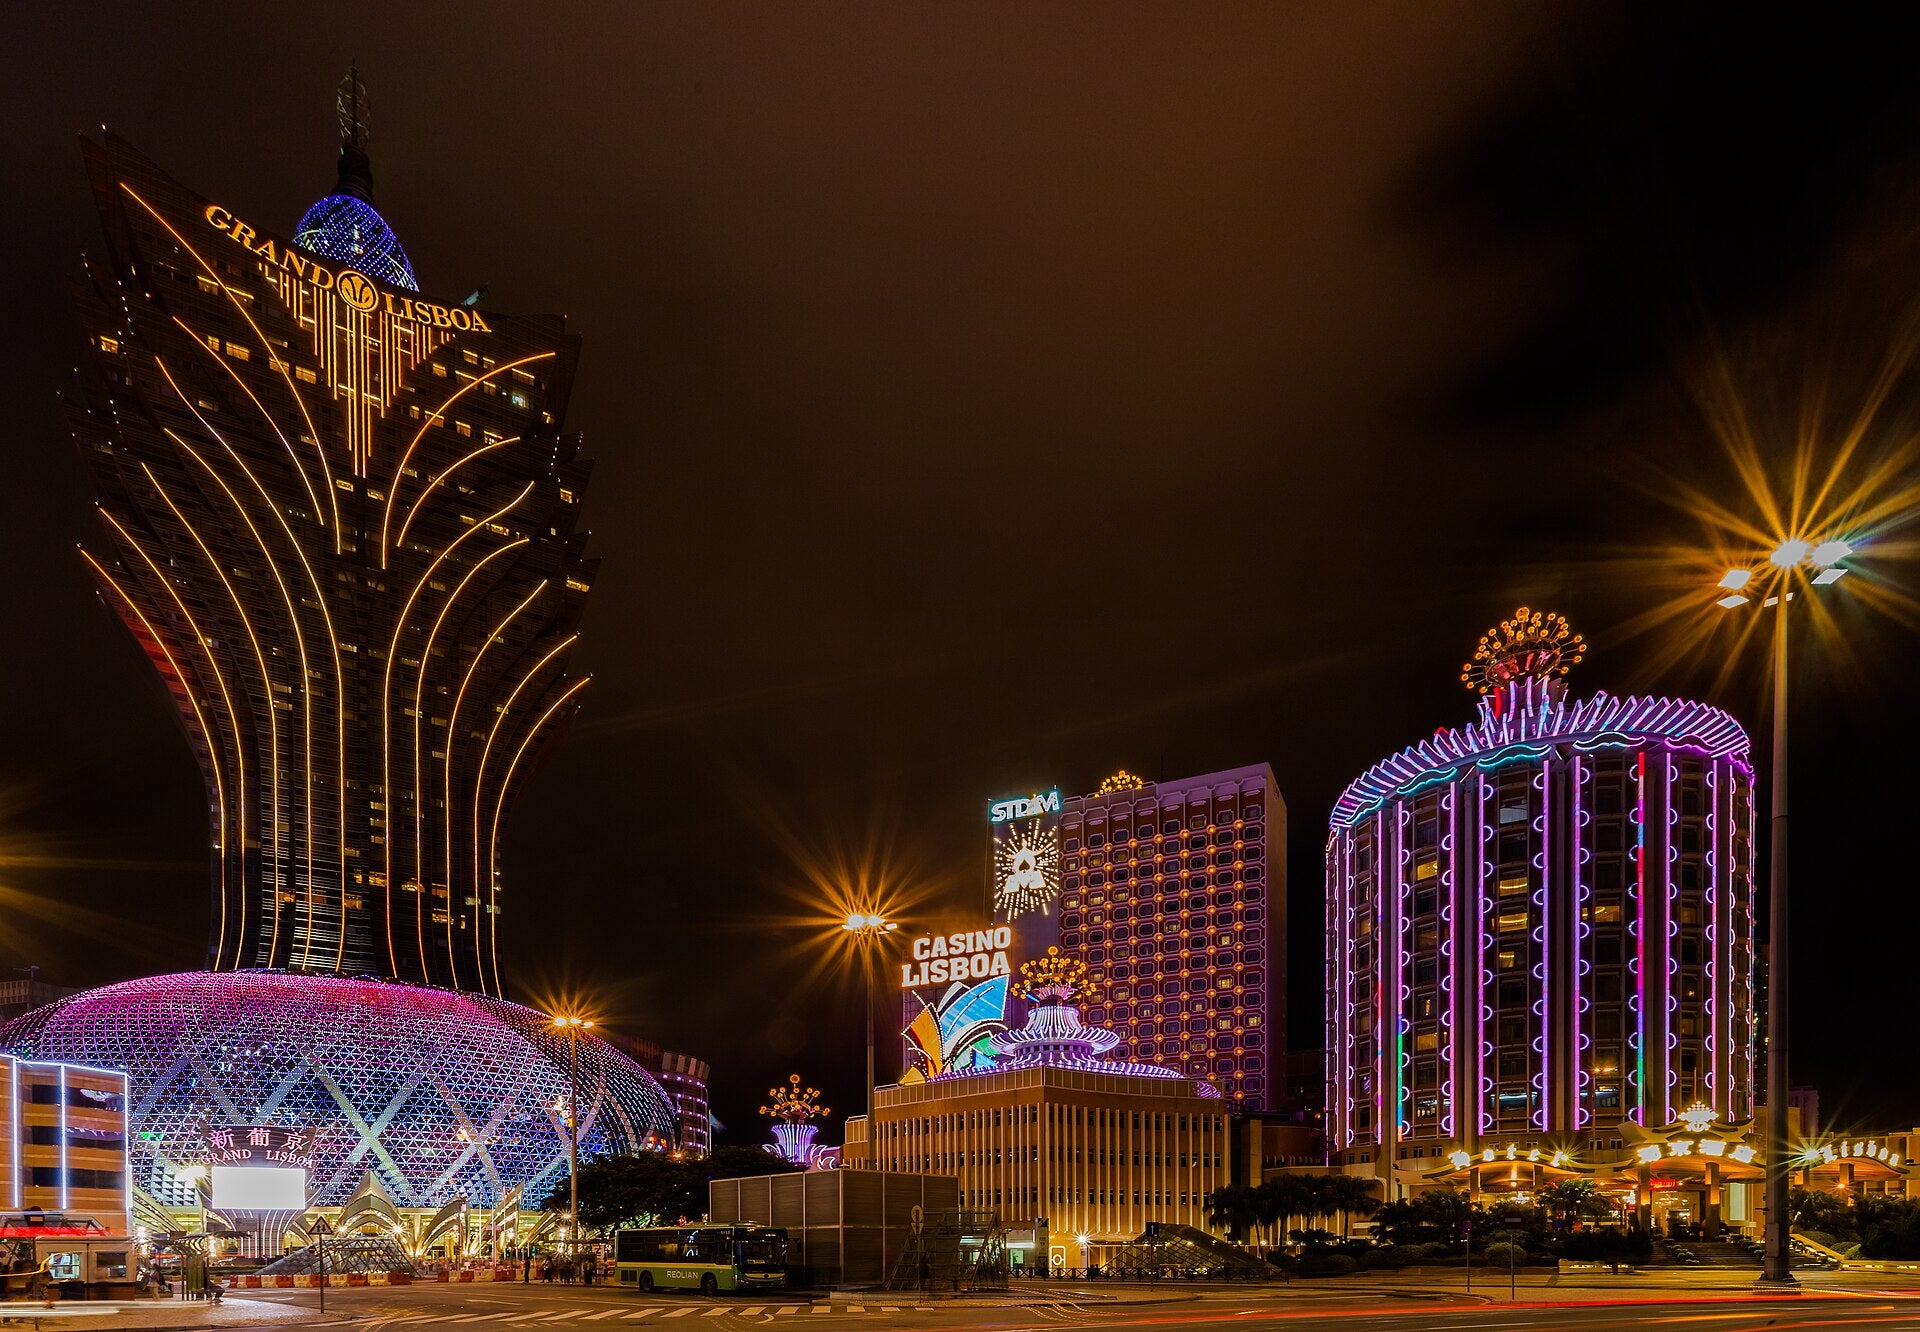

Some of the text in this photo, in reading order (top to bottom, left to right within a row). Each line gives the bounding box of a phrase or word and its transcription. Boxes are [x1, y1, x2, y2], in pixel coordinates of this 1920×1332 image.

[205, 205, 492, 333] GRAND LISBOA
[913, 926, 1011, 960] CASINO
[901, 951, 1011, 987] LISBOA
[208, 1127, 307, 1150] 新葡京
[200, 1148, 314, 1169] GRAND LISBOA
[666, 1270, 699, 1279] REOLIAN
